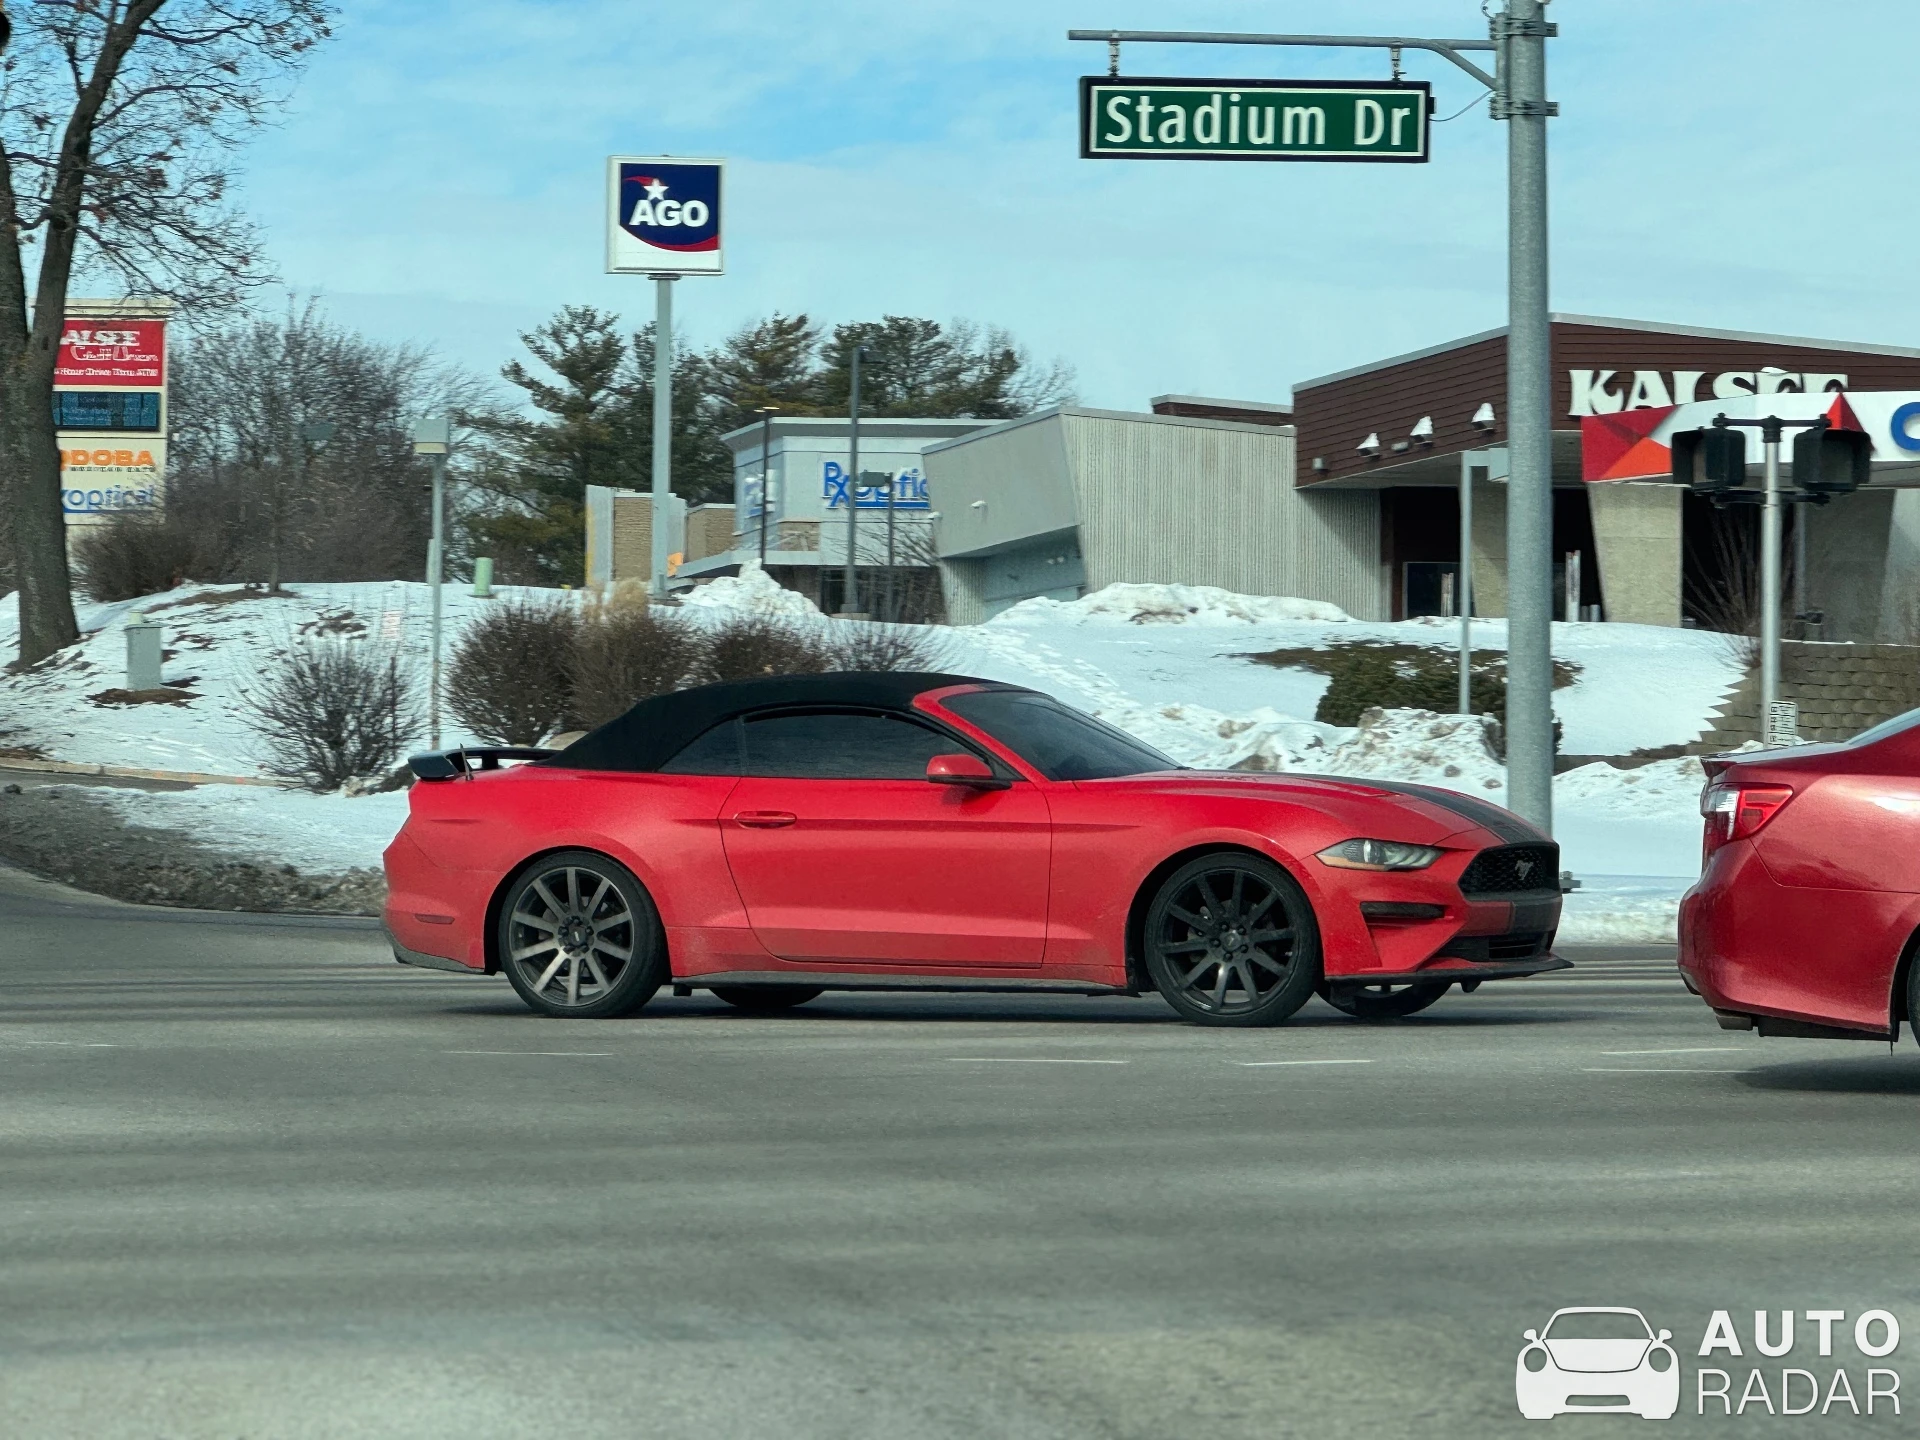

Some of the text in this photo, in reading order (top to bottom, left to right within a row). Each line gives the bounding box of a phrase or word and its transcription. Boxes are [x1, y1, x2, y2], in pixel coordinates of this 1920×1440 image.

[1104, 93, 1411, 146] Stadium Dr
[629, 199, 709, 227] AGO
[60, 329, 140, 346] ALSEE
